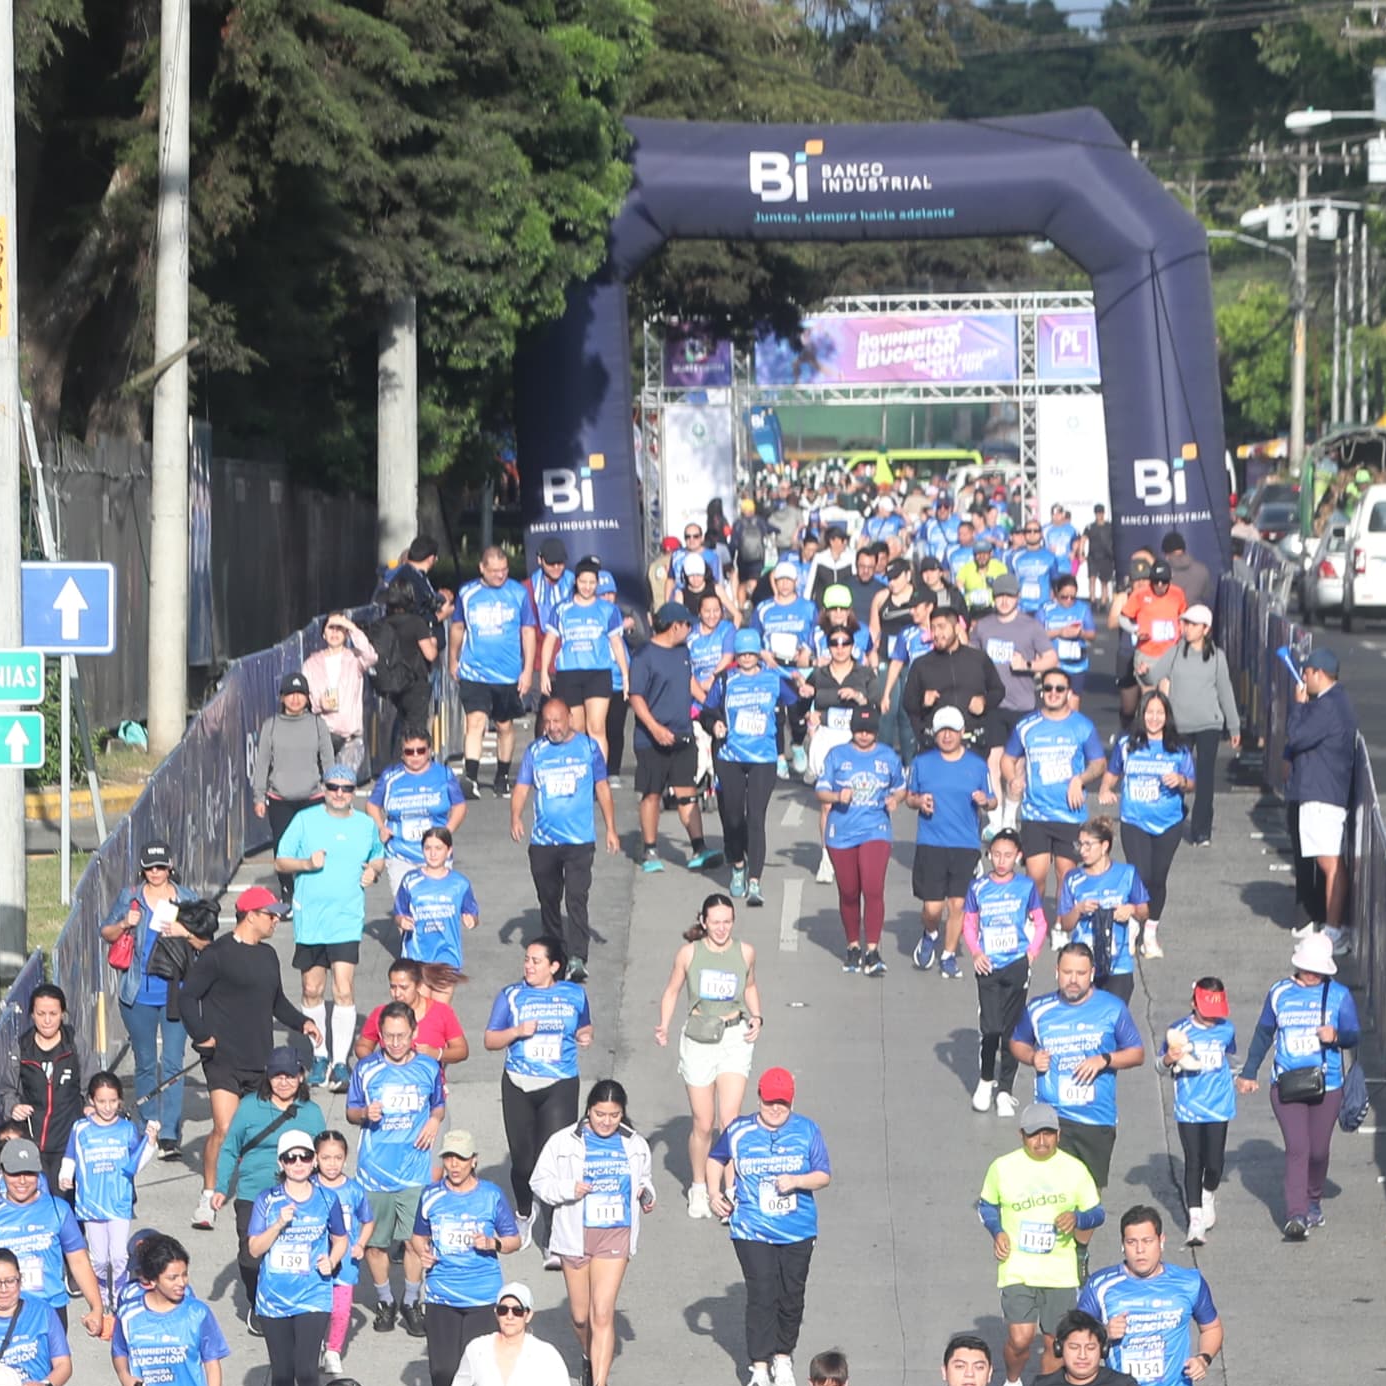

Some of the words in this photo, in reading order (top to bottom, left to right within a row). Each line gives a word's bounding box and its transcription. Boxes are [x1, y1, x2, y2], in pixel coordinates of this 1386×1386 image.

[749, 151, 809, 202] Bi
[822, 163, 883, 178] BANCO
[822, 175, 932, 193] INDUSTRIAL
[1134, 458, 1186, 506] Bi
[543, 467, 594, 514] Bi
[531, 1045, 554, 1058] 312
[390, 1094, 412, 1109] 271
[768, 1197, 792, 1210] 063
[1011, 1192, 1068, 1212] adidas
[595, 1205, 617, 1219] 111
[445, 1232, 470, 1247] 240
[1022, 1233, 1053, 1250] 1144
[278, 1253, 303, 1268] 139
[1128, 1362, 1160, 1375] 1154
